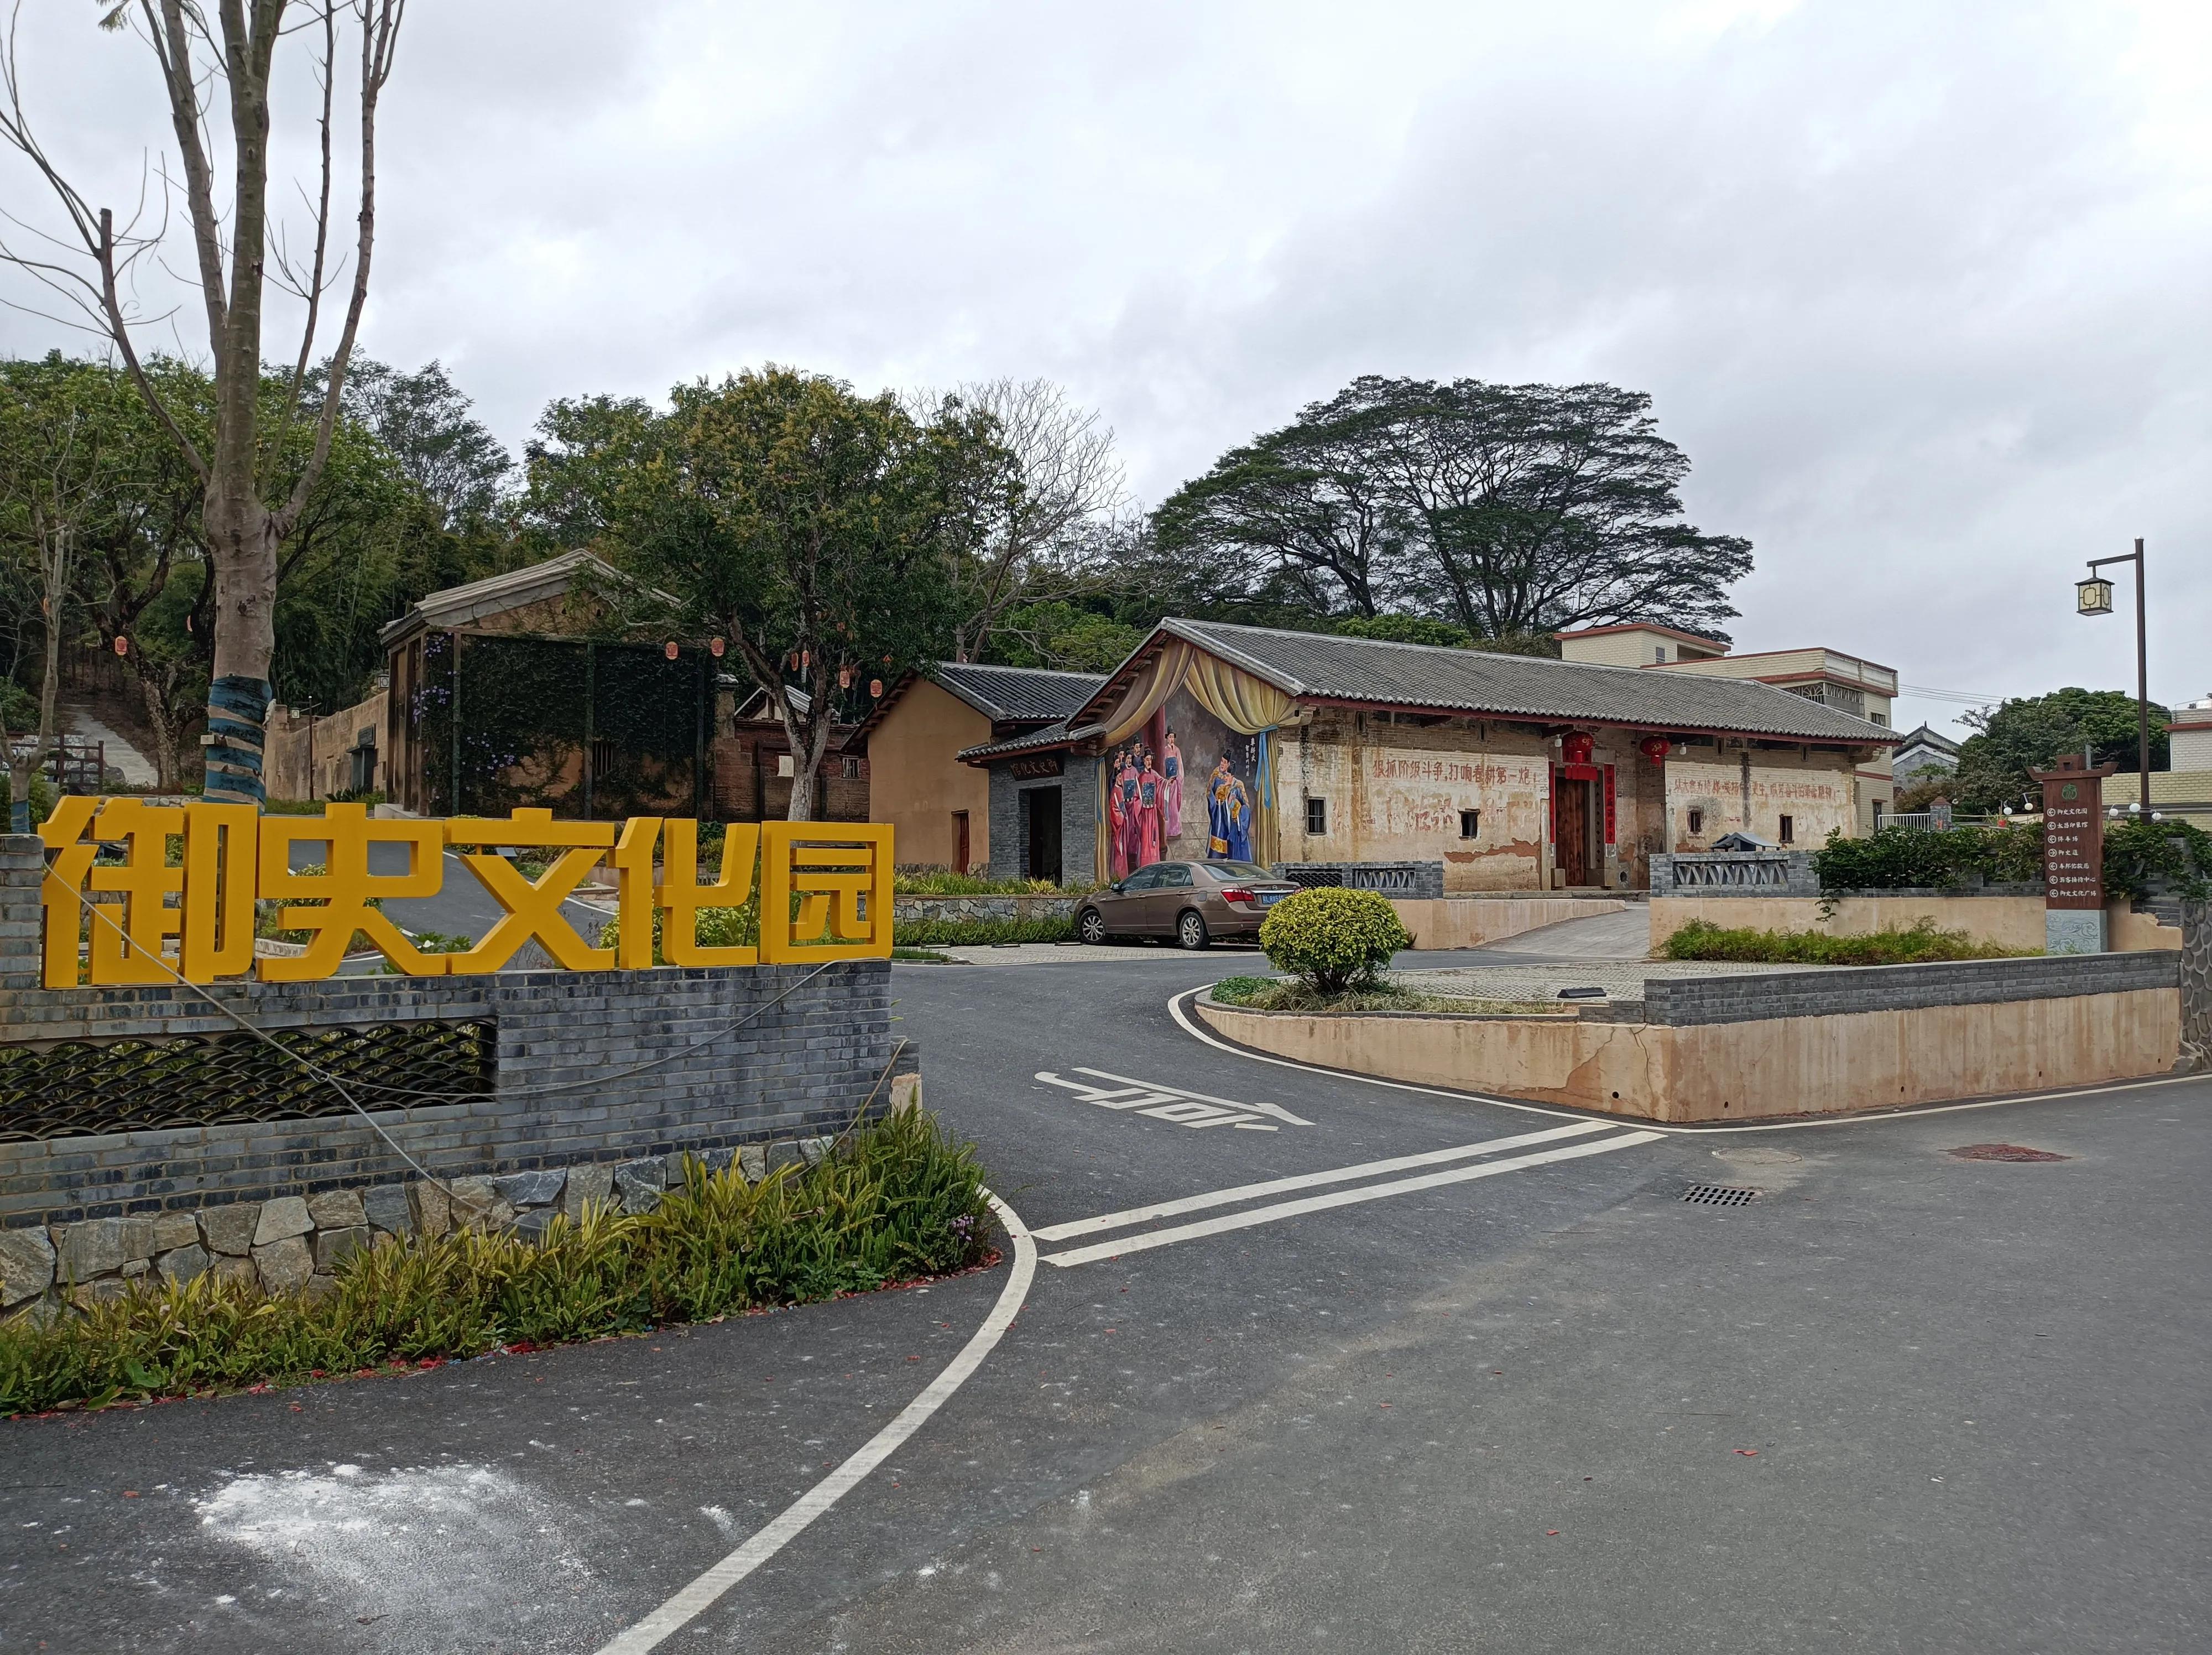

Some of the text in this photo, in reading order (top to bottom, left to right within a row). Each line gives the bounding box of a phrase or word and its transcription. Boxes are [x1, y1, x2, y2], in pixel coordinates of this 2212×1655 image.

[38, 795, 894, 989] 御史文化园
